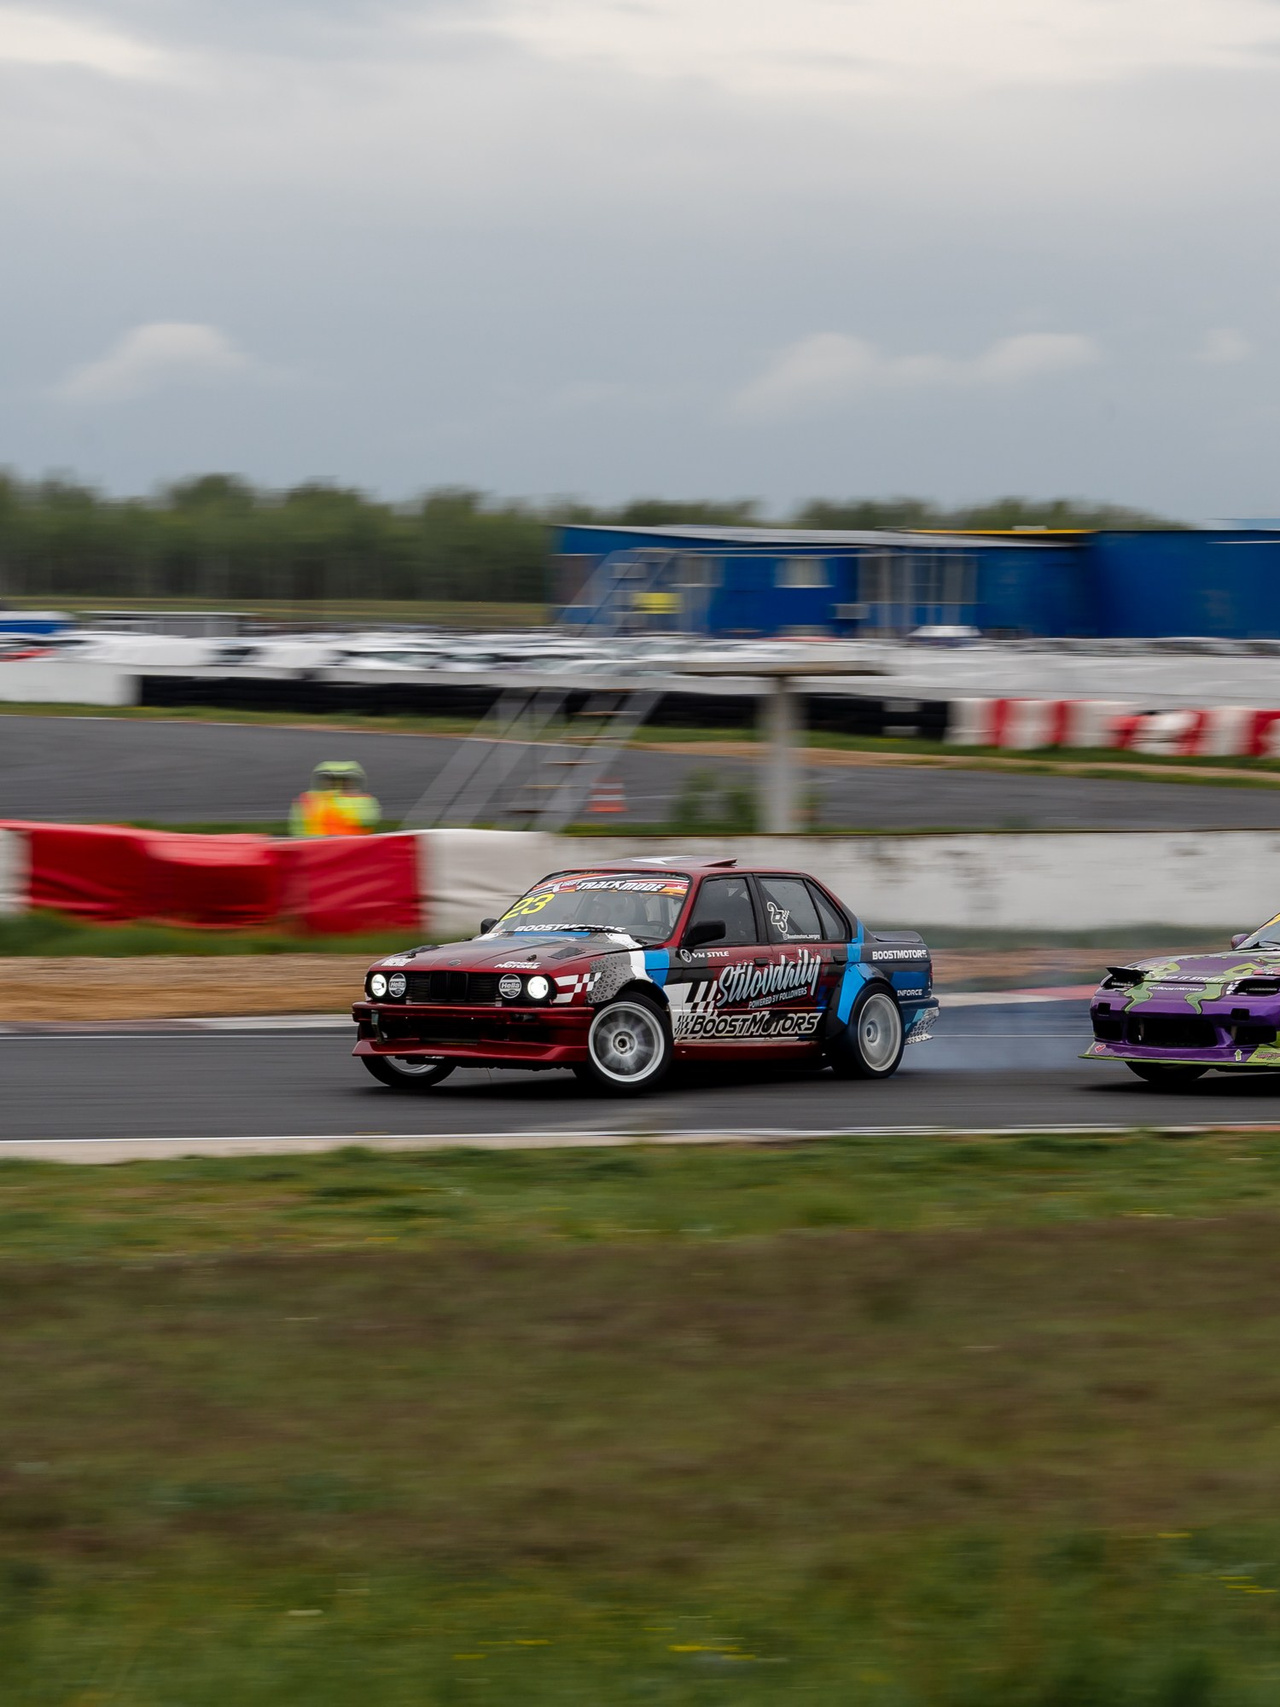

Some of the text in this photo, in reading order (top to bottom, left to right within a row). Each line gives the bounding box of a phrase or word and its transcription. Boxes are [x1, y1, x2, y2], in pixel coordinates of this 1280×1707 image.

[502, 893, 554, 921] 23
[748, 987, 808, 1009] POWERED BY FOLLOWERS
